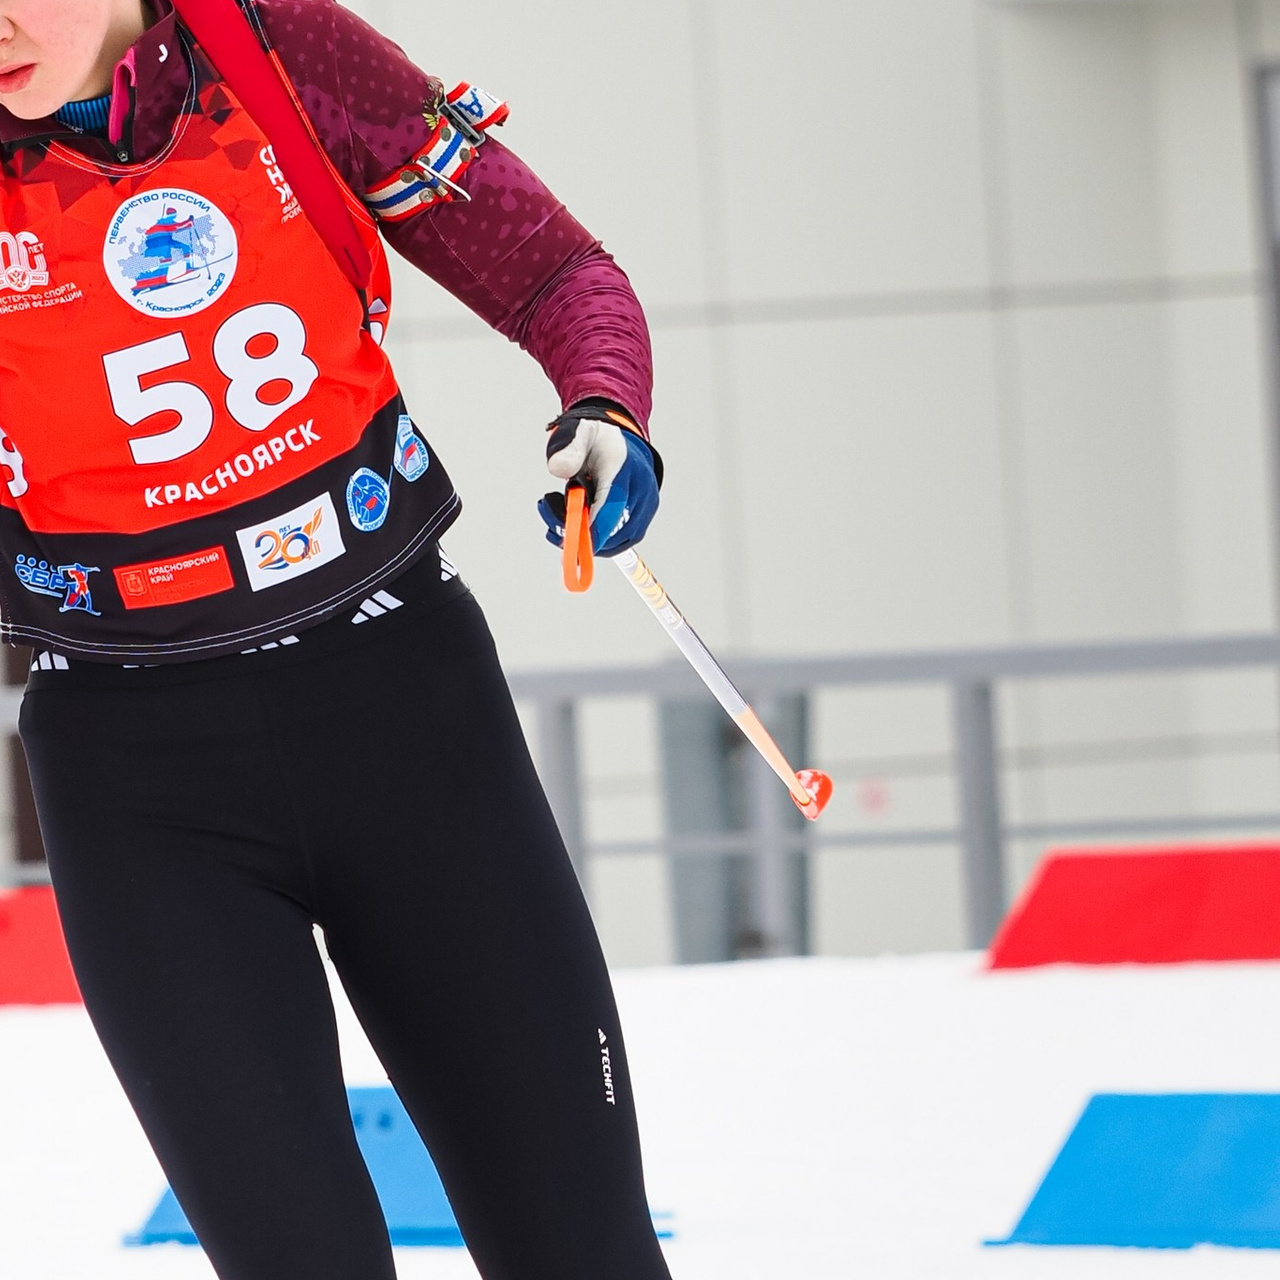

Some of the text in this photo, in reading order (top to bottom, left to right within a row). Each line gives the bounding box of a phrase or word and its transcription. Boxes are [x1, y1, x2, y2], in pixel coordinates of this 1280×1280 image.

[109, 192, 211, 245] ПЕРВЕНСТВО РОССИИ
[32, 290, 83, 308] ФЕДЕРАЦИИ
[43, 282, 76, 300] СПОРТА
[145, 296, 205, 313] Красноярск
[101, 301, 320, 466] 58
[144, 419, 322, 508] КРАСНОЯРСК
[147, 552, 220, 576] КРАСНОЯРСКИЙ
[150, 573, 174, 585] КРАЙ
[601, 1046, 615, 1106] TECHFIT
